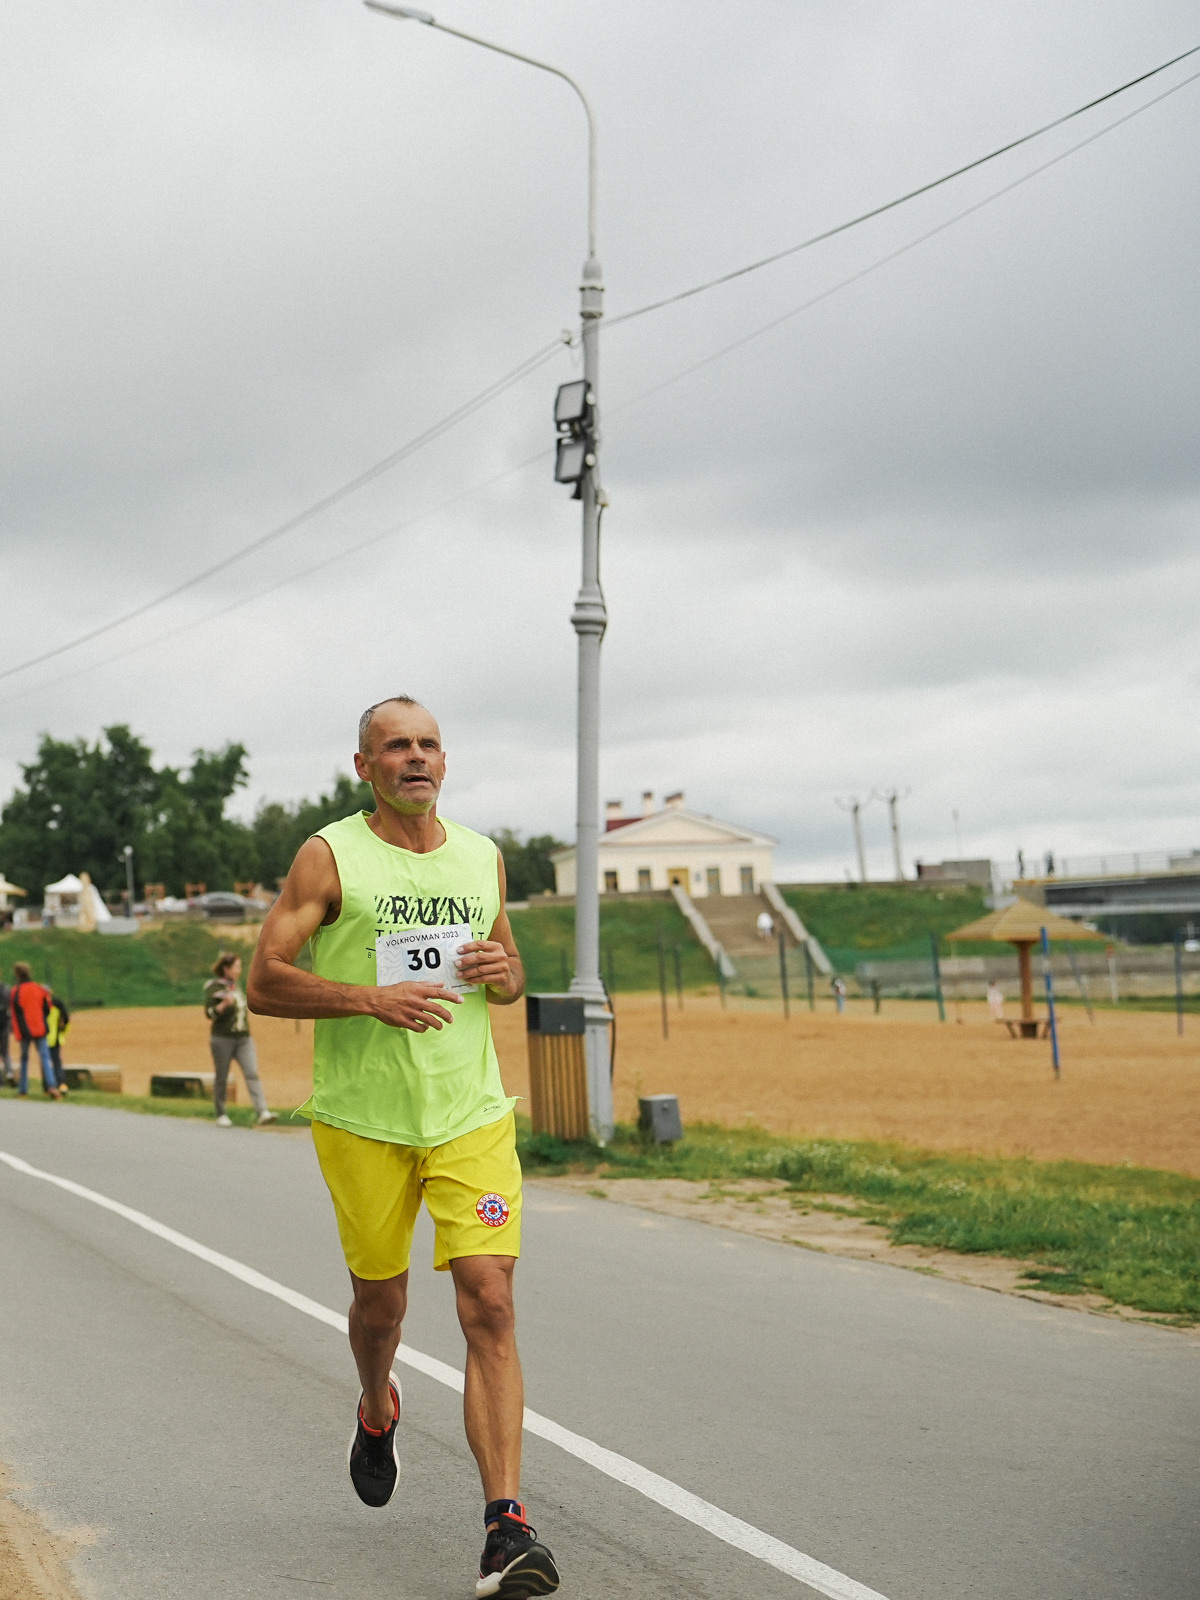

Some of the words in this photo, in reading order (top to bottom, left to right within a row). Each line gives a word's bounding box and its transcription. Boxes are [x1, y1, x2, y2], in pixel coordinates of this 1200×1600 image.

[390, 896, 470, 925] RUN
[385, 933, 440, 947] VOLKHOVMAN
[442, 931, 459, 940] 2023
[407, 947, 441, 971] 30
[479, 1213, 507, 1226] РОССИИ
